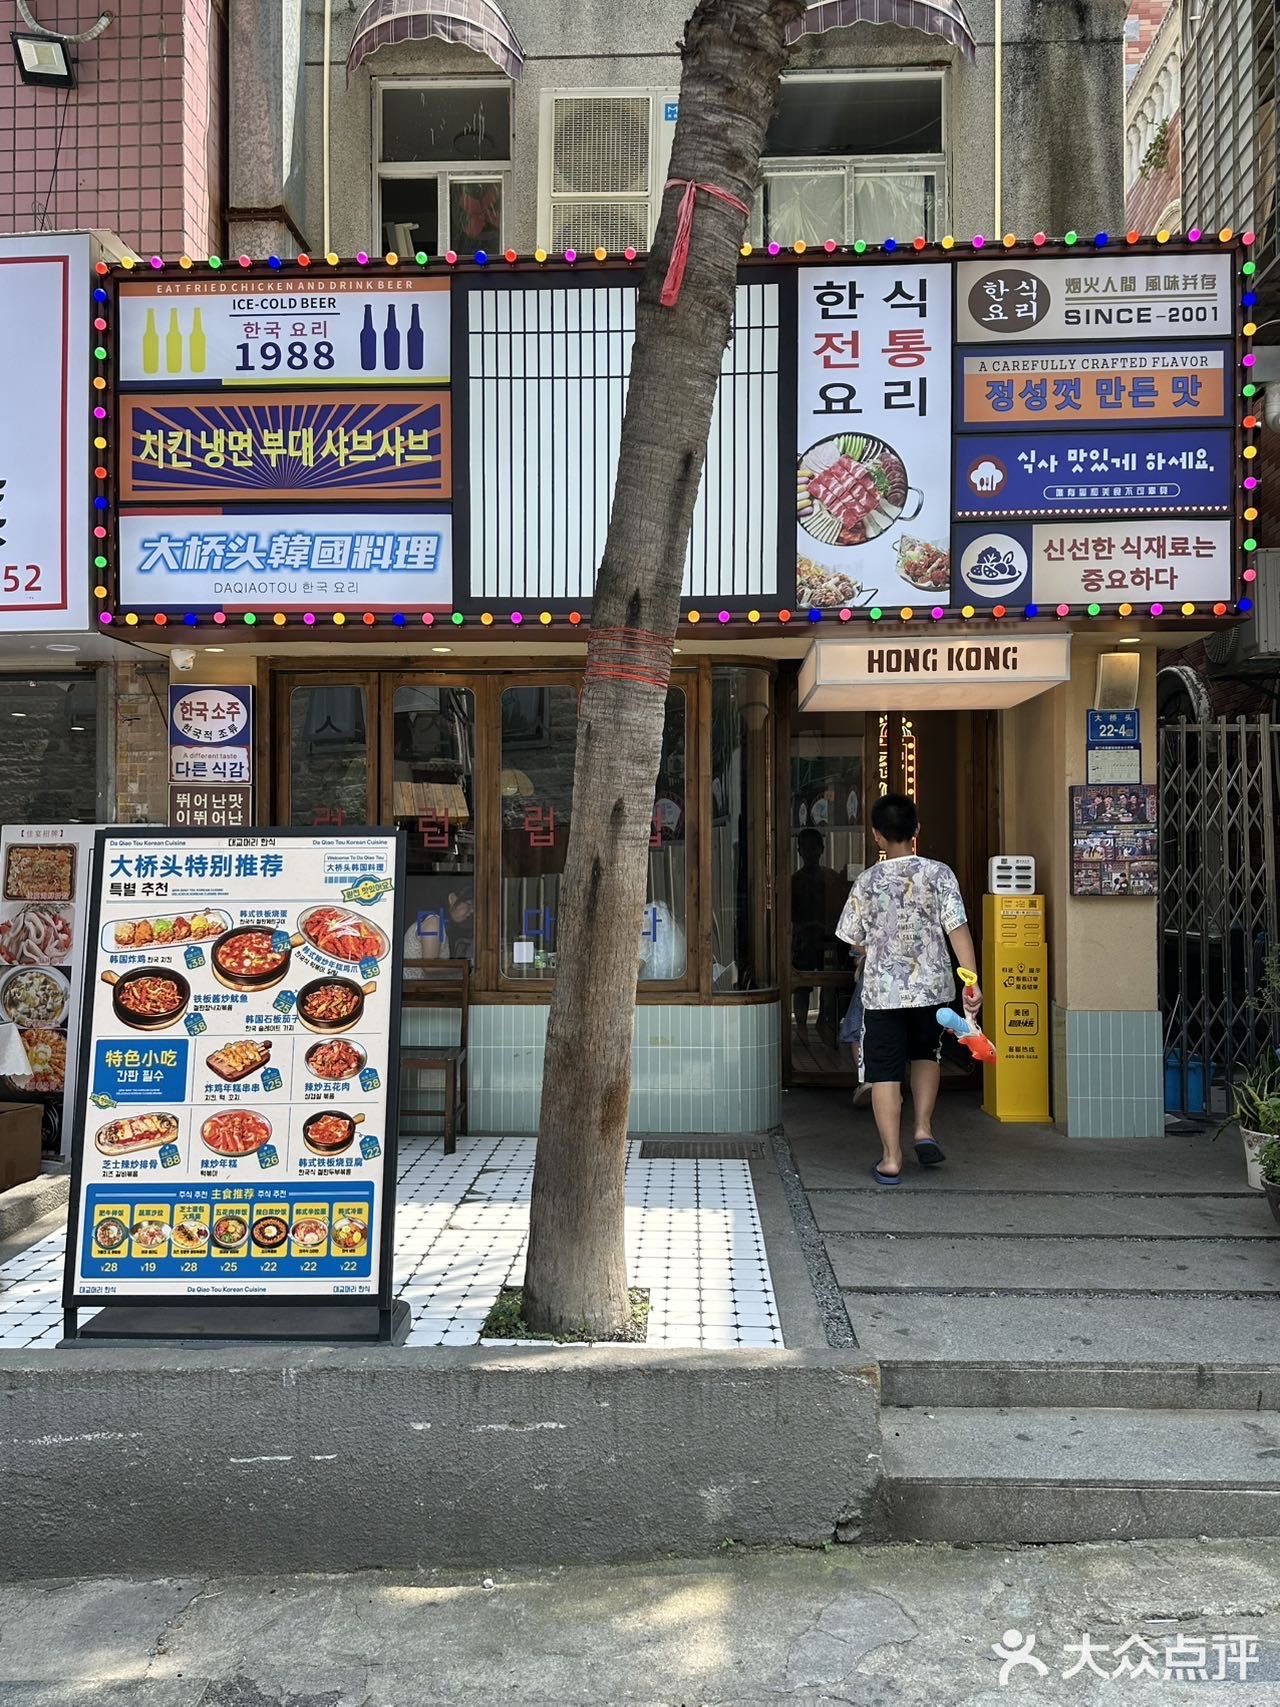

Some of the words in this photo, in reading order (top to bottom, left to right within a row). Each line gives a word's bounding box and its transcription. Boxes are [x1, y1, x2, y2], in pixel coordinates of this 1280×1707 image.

[156, 284, 181, 294] EAT
[185, 283, 227, 293] FRIED
[231, 282, 294, 292] CHICKEN
[298, 281, 325, 291] AND
[330, 281, 373, 290] DRINK
[378, 280, 413, 289] BEER
[232, 298, 297, 311] ICE-COLD
[301, 297, 337, 309] BEER
[243, 321, 281, 340] 한국
[289, 320, 328, 339] 요리
[235, 341, 335, 371] 1988
[978, 360, 988, 372] A
[992, 358, 1077, 371] CAREFULLY
[1082, 357, 1147, 370] CRAFTED
[1152, 356, 1209, 368] FLAVOR
[985, 378, 1081, 413] 정성껏
[1096, 376, 1158, 409] 만든
[1171, 375, 1203, 408] 맛
[139, 428, 192, 469] 치킨
[200, 427, 252, 467] 냉면
[260, 427, 315, 468] 부대
[321, 427, 432, 467] 샤브샤브
[1017, 449, 1058, 473] 식사
[1067, 448, 1137, 473] 맛있게
[140, 533, 438, 572] 大桥头韓國料理
[1043, 537, 1116, 562] 신선한
[1120, 535, 1217, 561] 식재료는
[214, 582, 297, 594] DAQIAOTOU
[302, 582, 328, 594] 한국
[333, 582, 359, 595] 요리
[1081, 567, 1178, 592] 중요하다
[867, 648, 938, 673] HONG
[947, 646, 1018, 671] KONG
[180, 701, 209, 722] 한국
[211, 701, 241, 722] 소주
[175, 761, 208, 778] 다른
[211, 761, 245, 778] 식감
[109, 853, 284, 879] 大桥头特别推荐
[326, 863, 384, 872] 大桥头韩国料理
[109, 882, 137, 897] 특별
[141, 882, 169, 897] 추천
[109, 954, 146, 964] 韩国炸鸡
[245, 1014, 299, 1024] 韩国石板茄子
[105, 1048, 178, 1067] 特色小吃
[204, 1083, 260, 1093] 炸鸡年糕串串
[304, 1082, 350, 1092] 辣炒五花肉
[211, 1188, 254, 1200] 主食推荐
